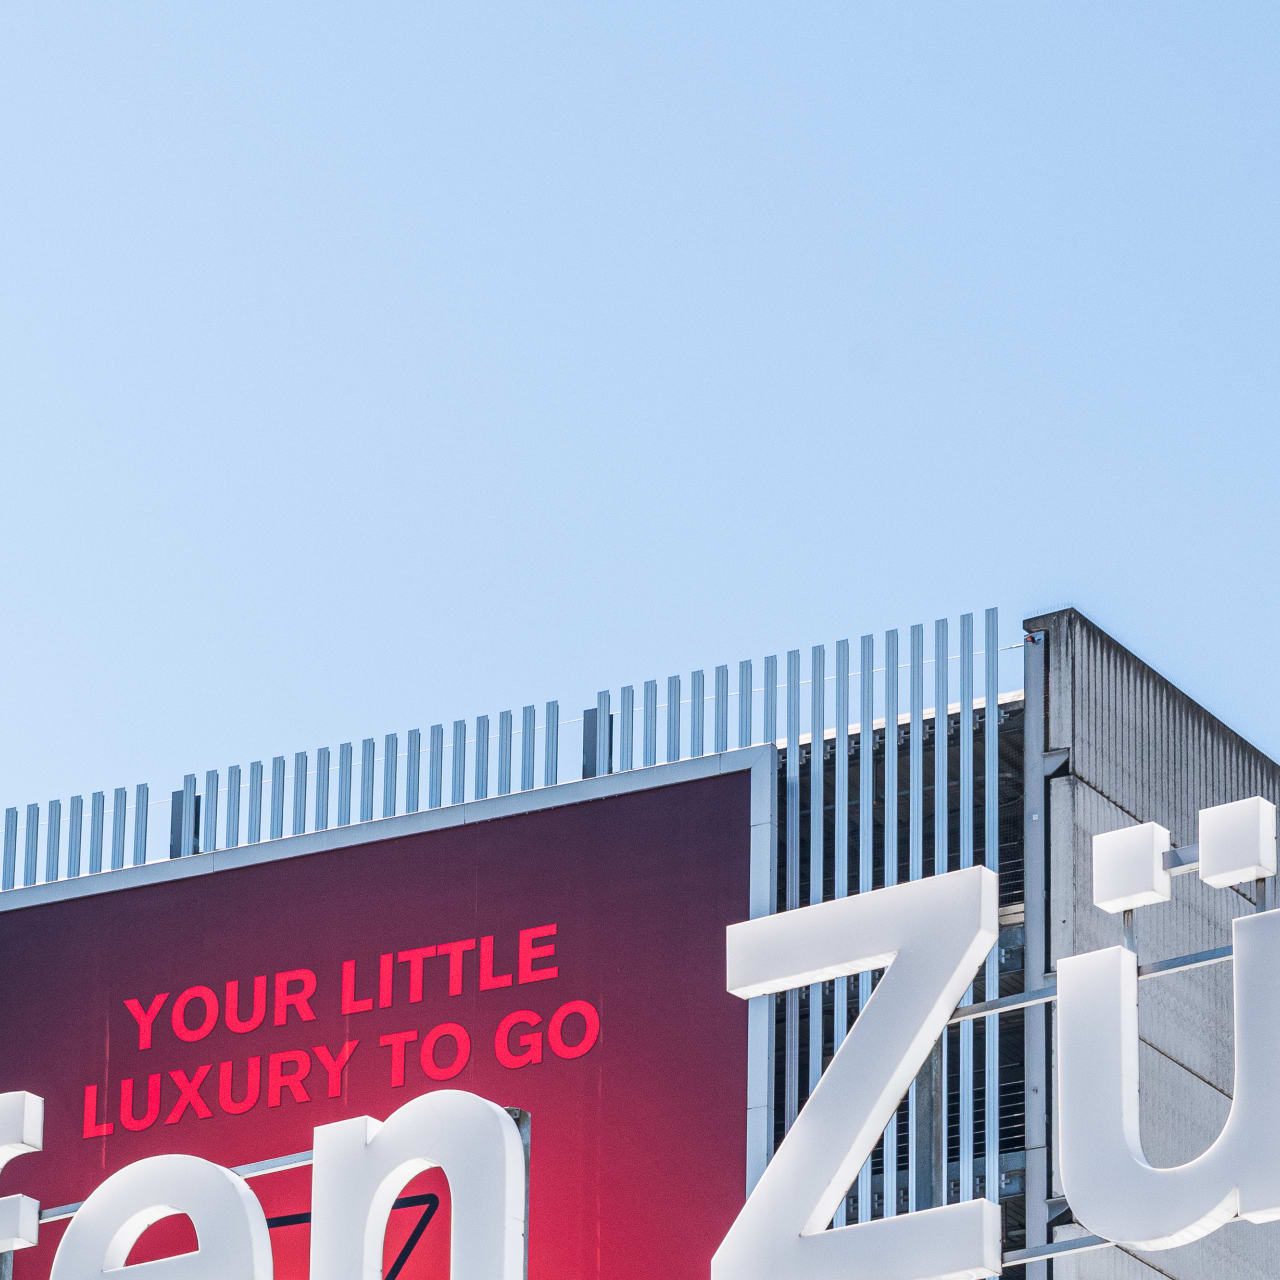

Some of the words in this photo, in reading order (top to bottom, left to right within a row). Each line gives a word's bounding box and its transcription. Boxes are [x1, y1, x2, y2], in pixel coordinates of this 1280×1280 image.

[123, 968, 318, 1051] YOUR
[340, 922, 560, 1016] LITTLE
[81, 1039, 360, 1140] LUXURY
[378, 1022, 472, 1088] TO
[494, 999, 601, 1070] GO
